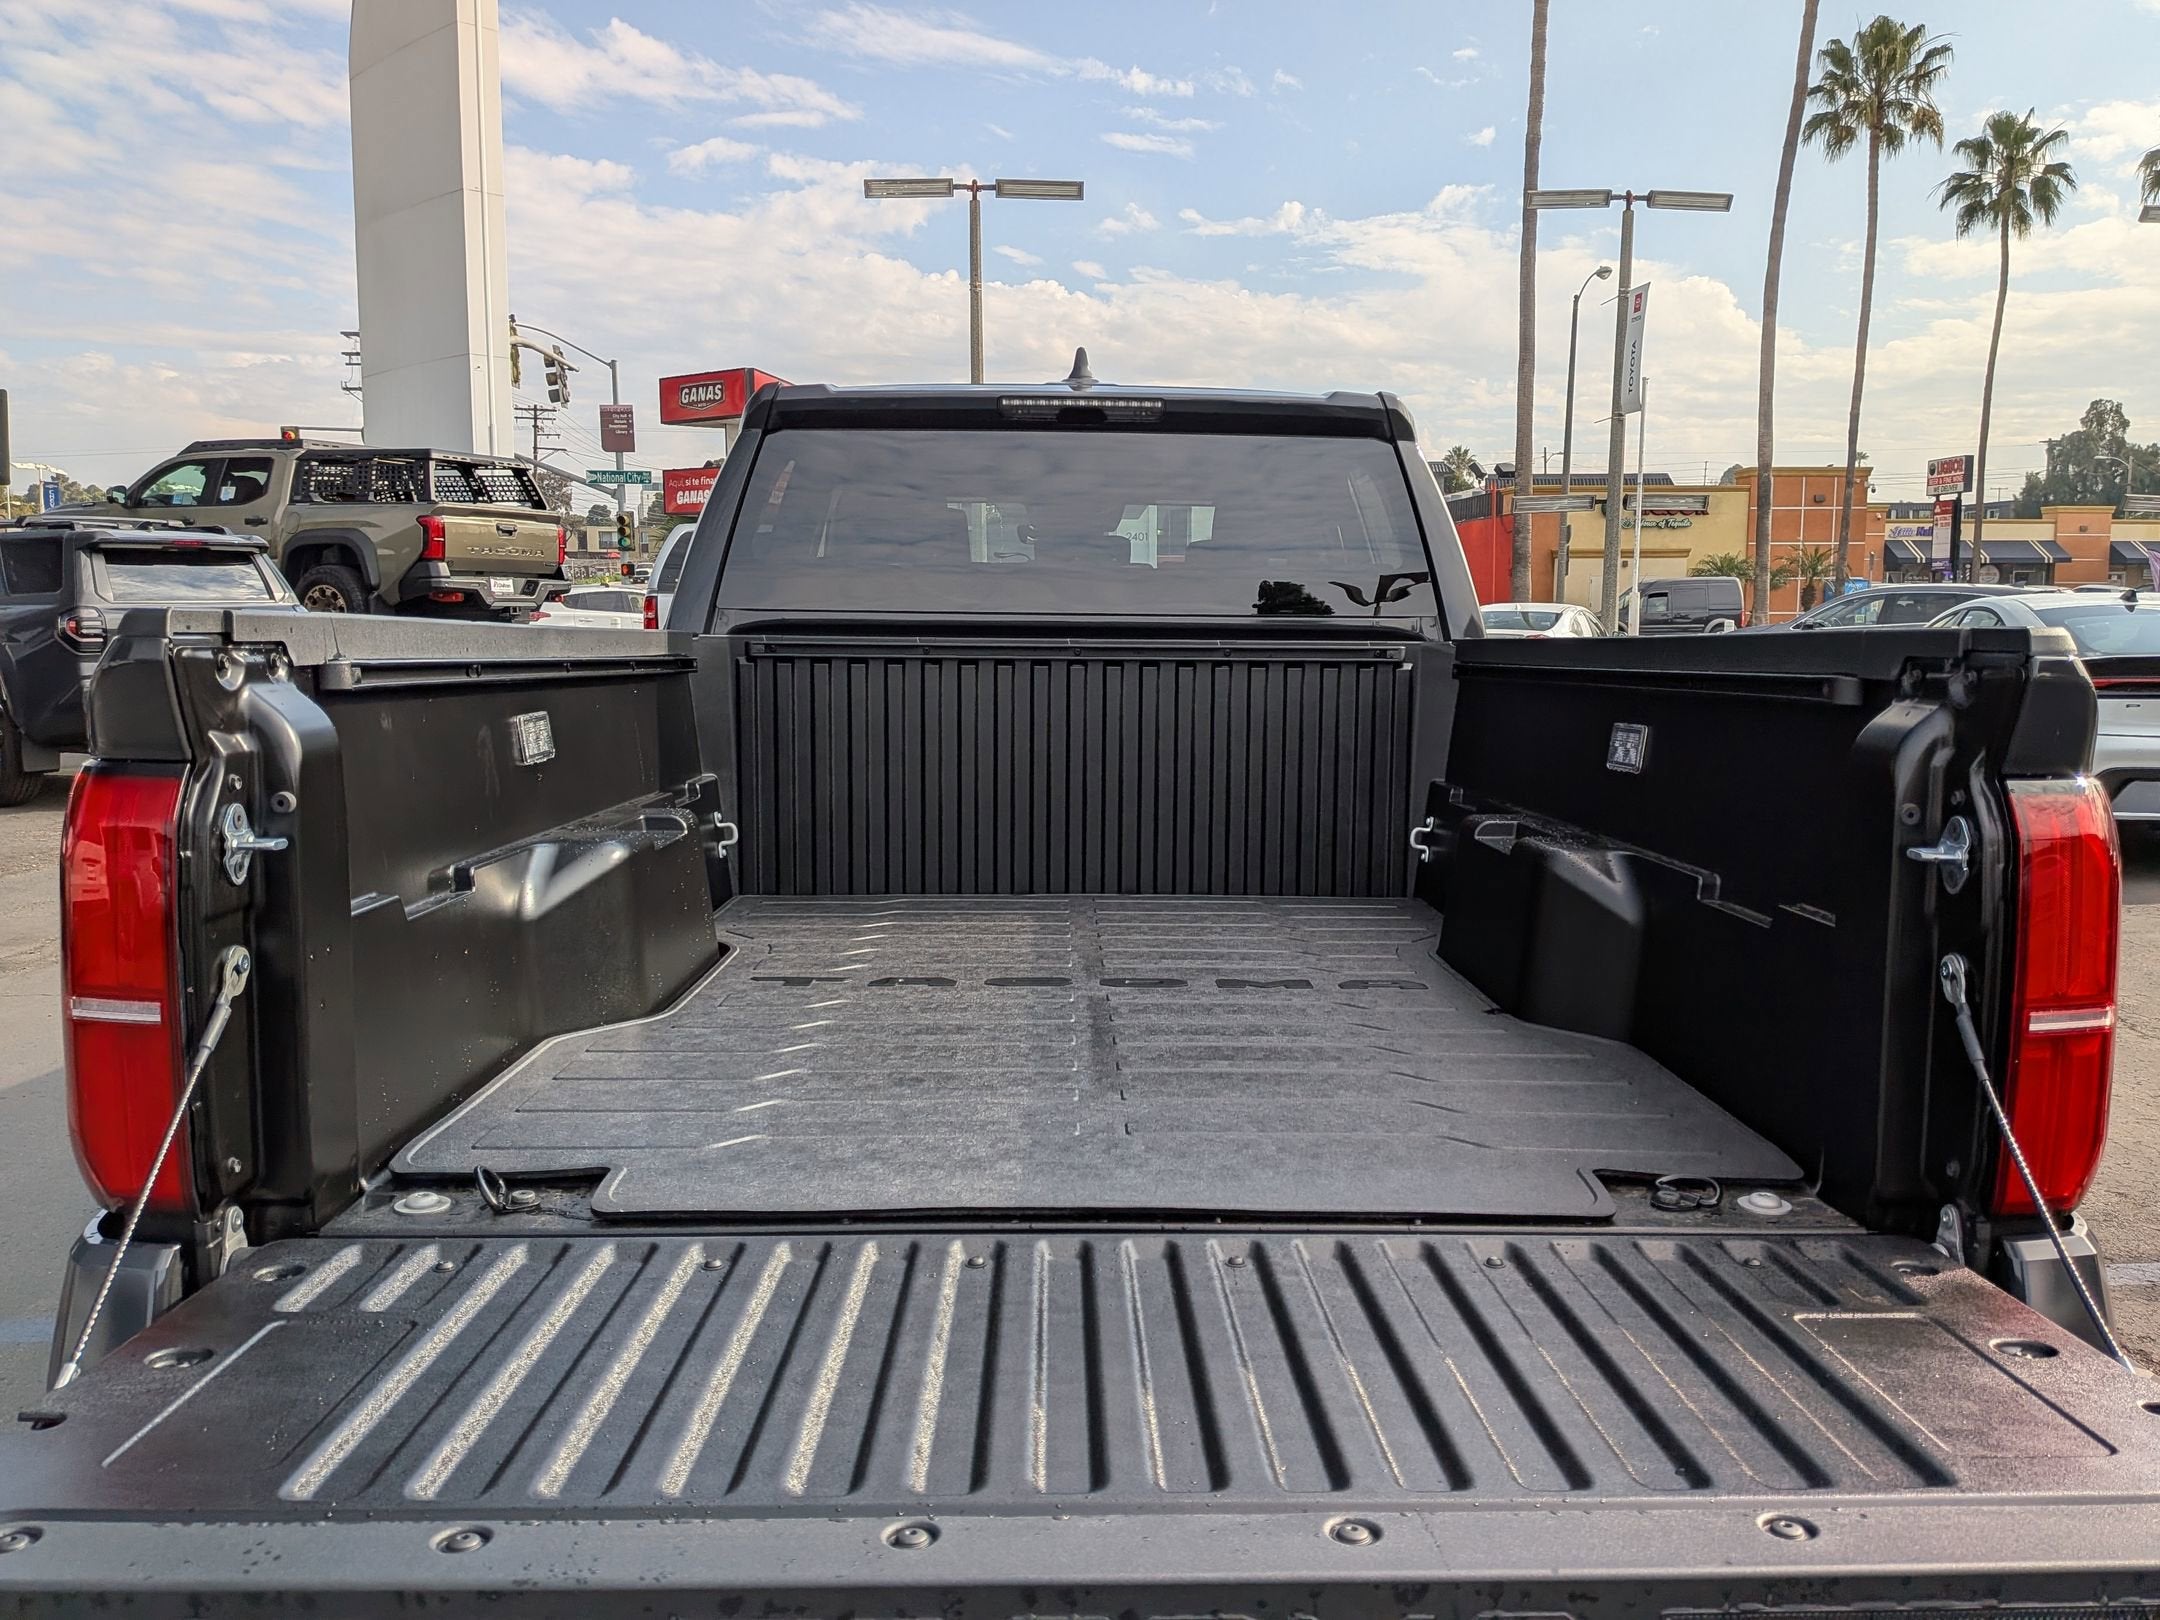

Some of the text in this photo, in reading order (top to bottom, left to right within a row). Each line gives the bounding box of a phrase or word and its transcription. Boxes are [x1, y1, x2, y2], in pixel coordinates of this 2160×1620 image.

[1628, 340, 1637, 395] TOYOTA
[681, 384, 722, 404] GANAS
[1937, 458, 1964, 475] LIQUOR
[597, 472, 626, 483] National
[626, 472, 641, 484] City
[692, 478, 700, 486] te
[1941, 484, 1958, 492] DELIVER
[676, 489, 710, 505] GANAS
[1657, 519, 1666, 528] of
[1666, 518, 1691, 528] Tequila
[1126, 532, 1148, 541] 2401
[466, 546, 545, 557] TACOMA
[750, 976, 1430, 989] TACOMA
